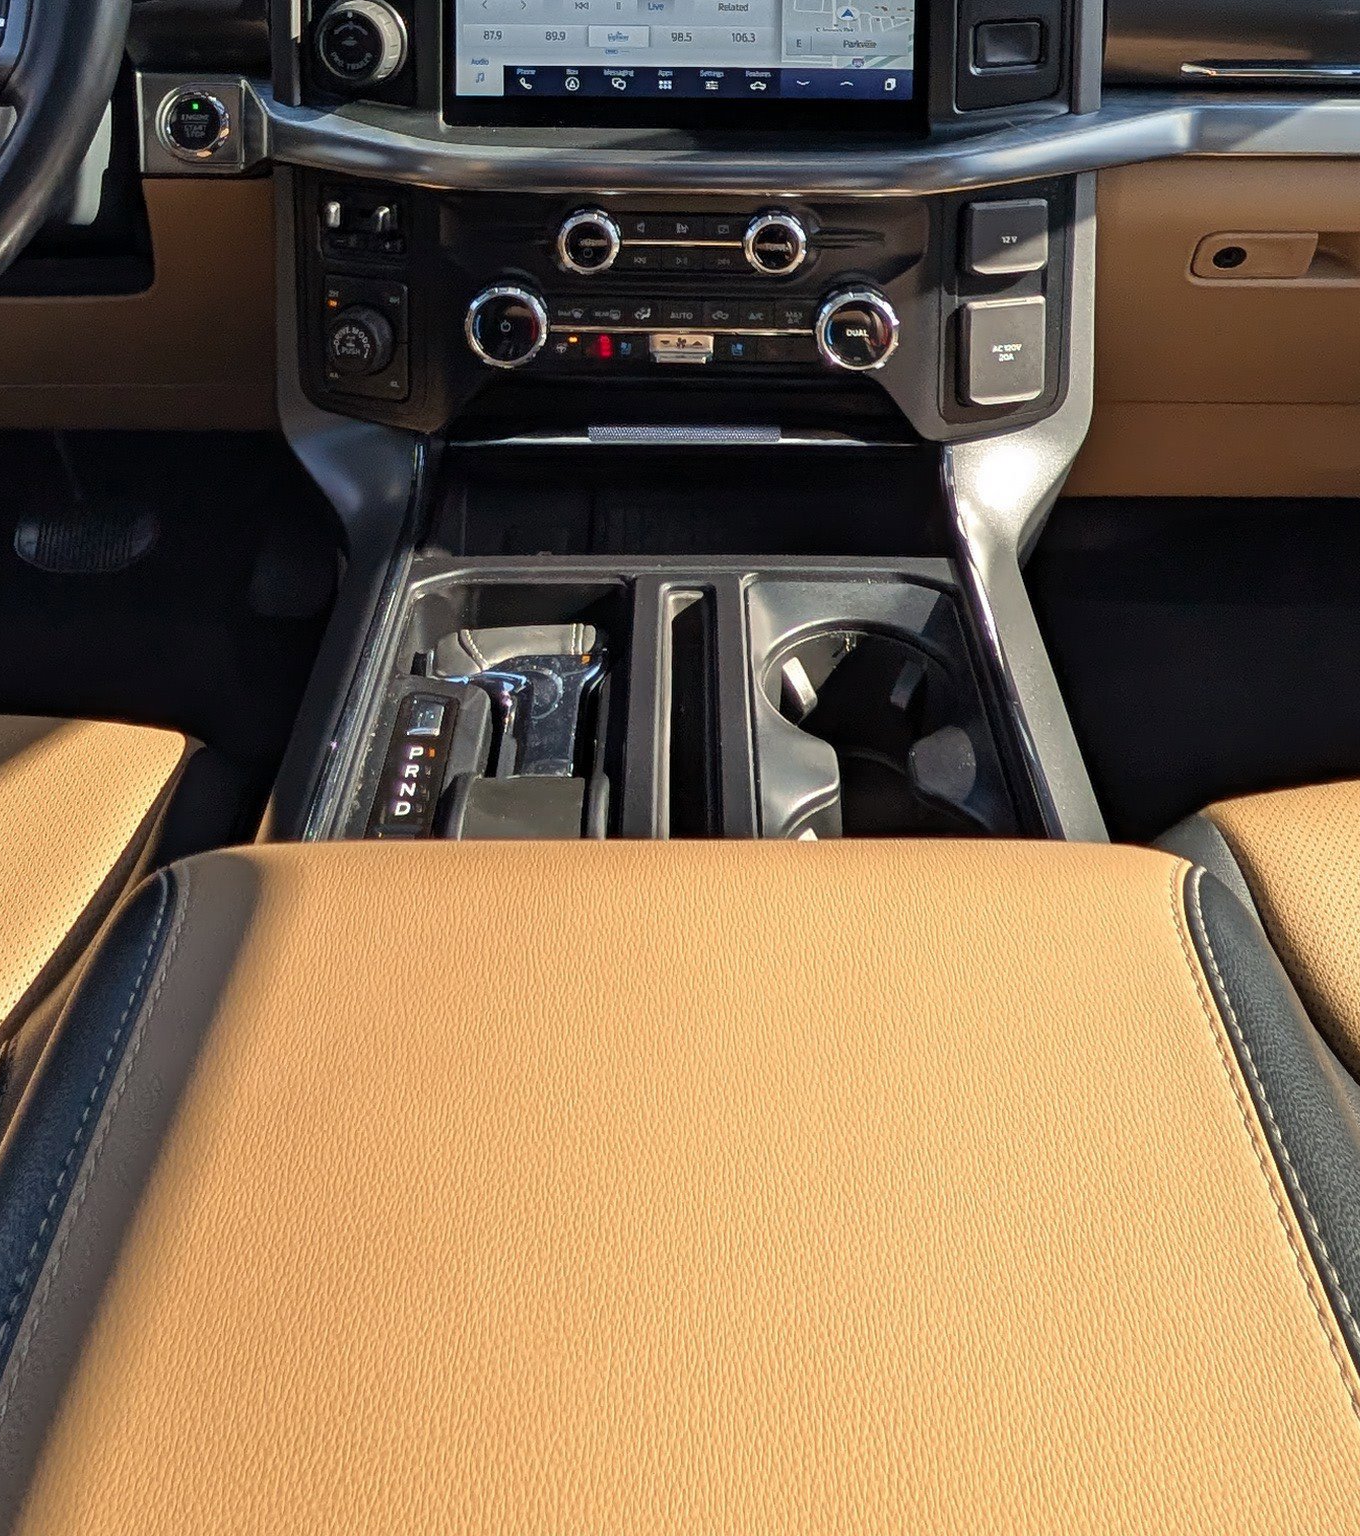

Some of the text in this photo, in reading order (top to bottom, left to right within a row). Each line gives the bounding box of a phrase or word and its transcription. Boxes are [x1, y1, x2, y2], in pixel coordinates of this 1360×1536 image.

[648, 2, 664, 11] Live
[718, 3, 749, 11] Related
[483, 30, 502, 41] 87.9
[545, 31, 566, 41] 89.9
[671, 33, 692, 42] 98.5
[732, 33, 756, 43] 106.3
[797, 39, 801, 47] E
[700, 70, 724, 78] Settings
[670, 311, 693, 320] AUTO
[845, 328, 869, 337] DUAL
[992, 344, 1022, 353] AC 120V
[999, 353, 1014, 362] 20A
[409, 746, 423, 760] P
[404, 764, 419, 778] R
[399, 782, 416, 797] N
[394, 801, 411, 816] D
